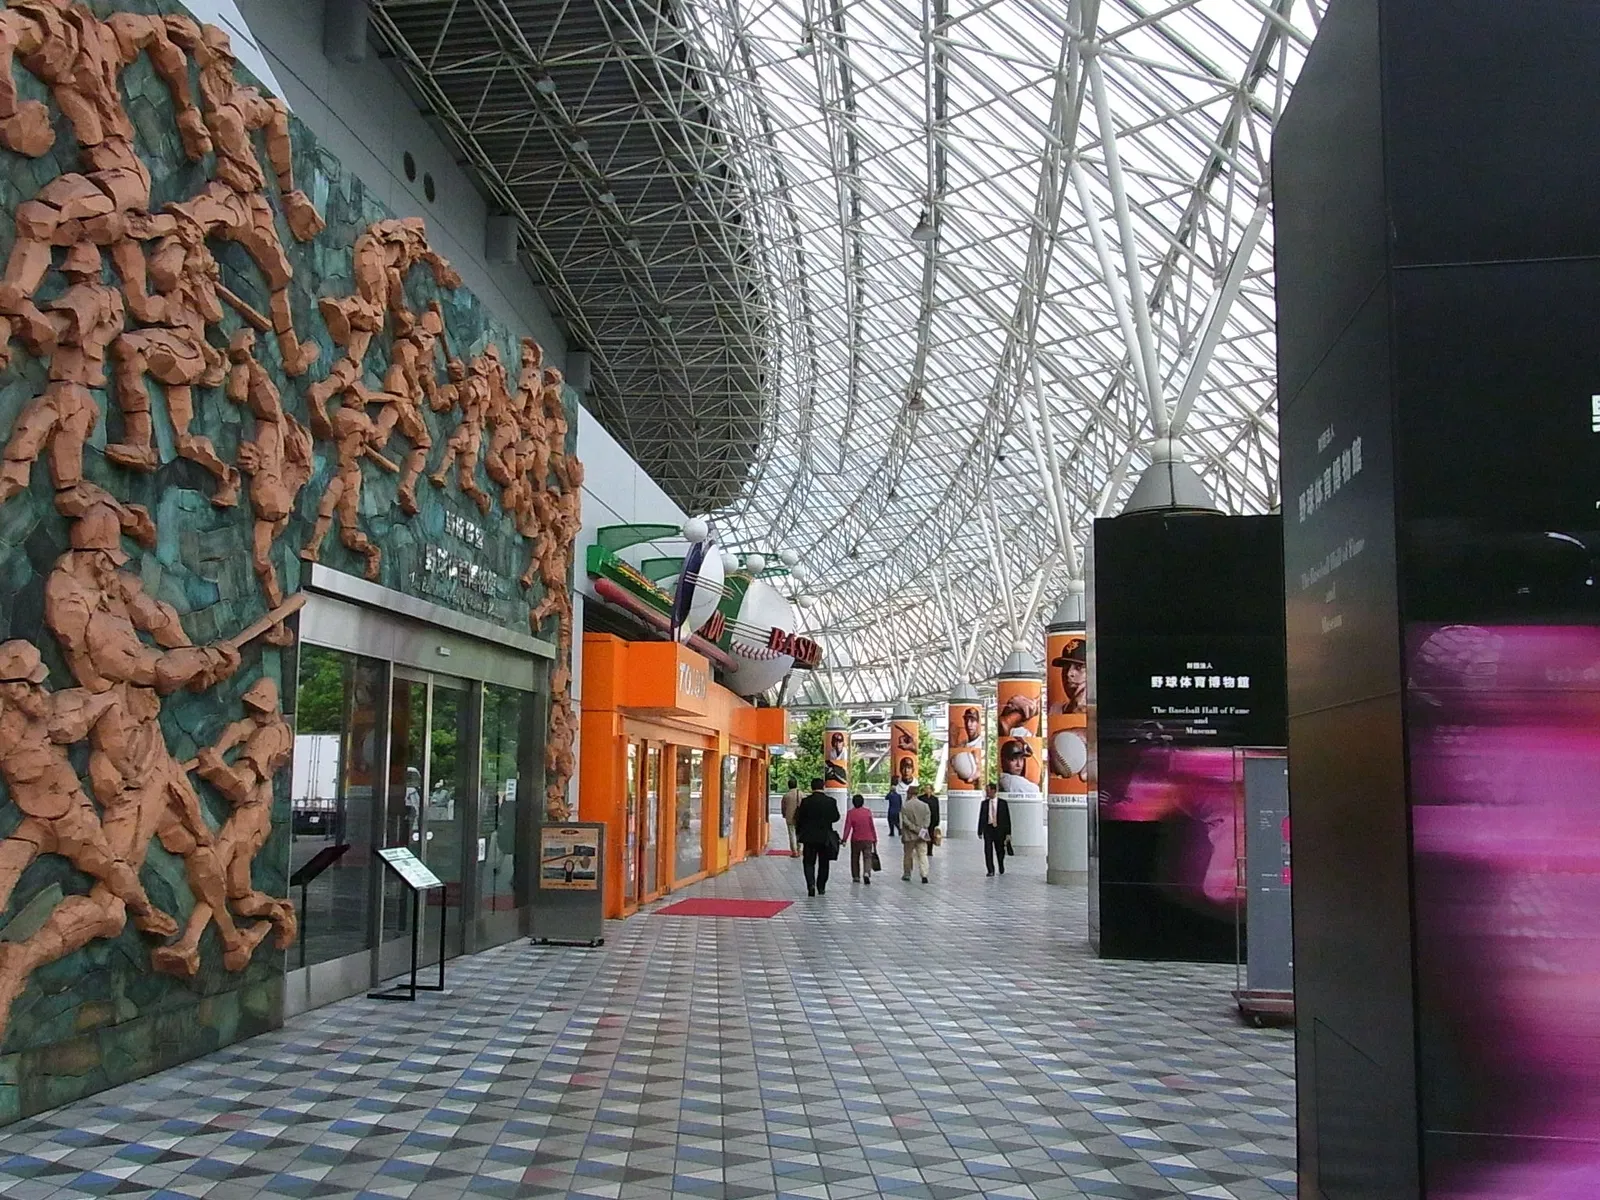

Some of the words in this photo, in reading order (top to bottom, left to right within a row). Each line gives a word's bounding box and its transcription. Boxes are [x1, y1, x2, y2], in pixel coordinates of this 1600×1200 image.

[1151, 676, 1250, 689] 野球体育博物館
[1151, 706, 1166, 714] The
[1168, 706, 1200, 714] Baseball
[1201, 706, 1218, 714] Hall
[1219, 706, 1228, 714] of
[1229, 706, 1250, 714] Fame
